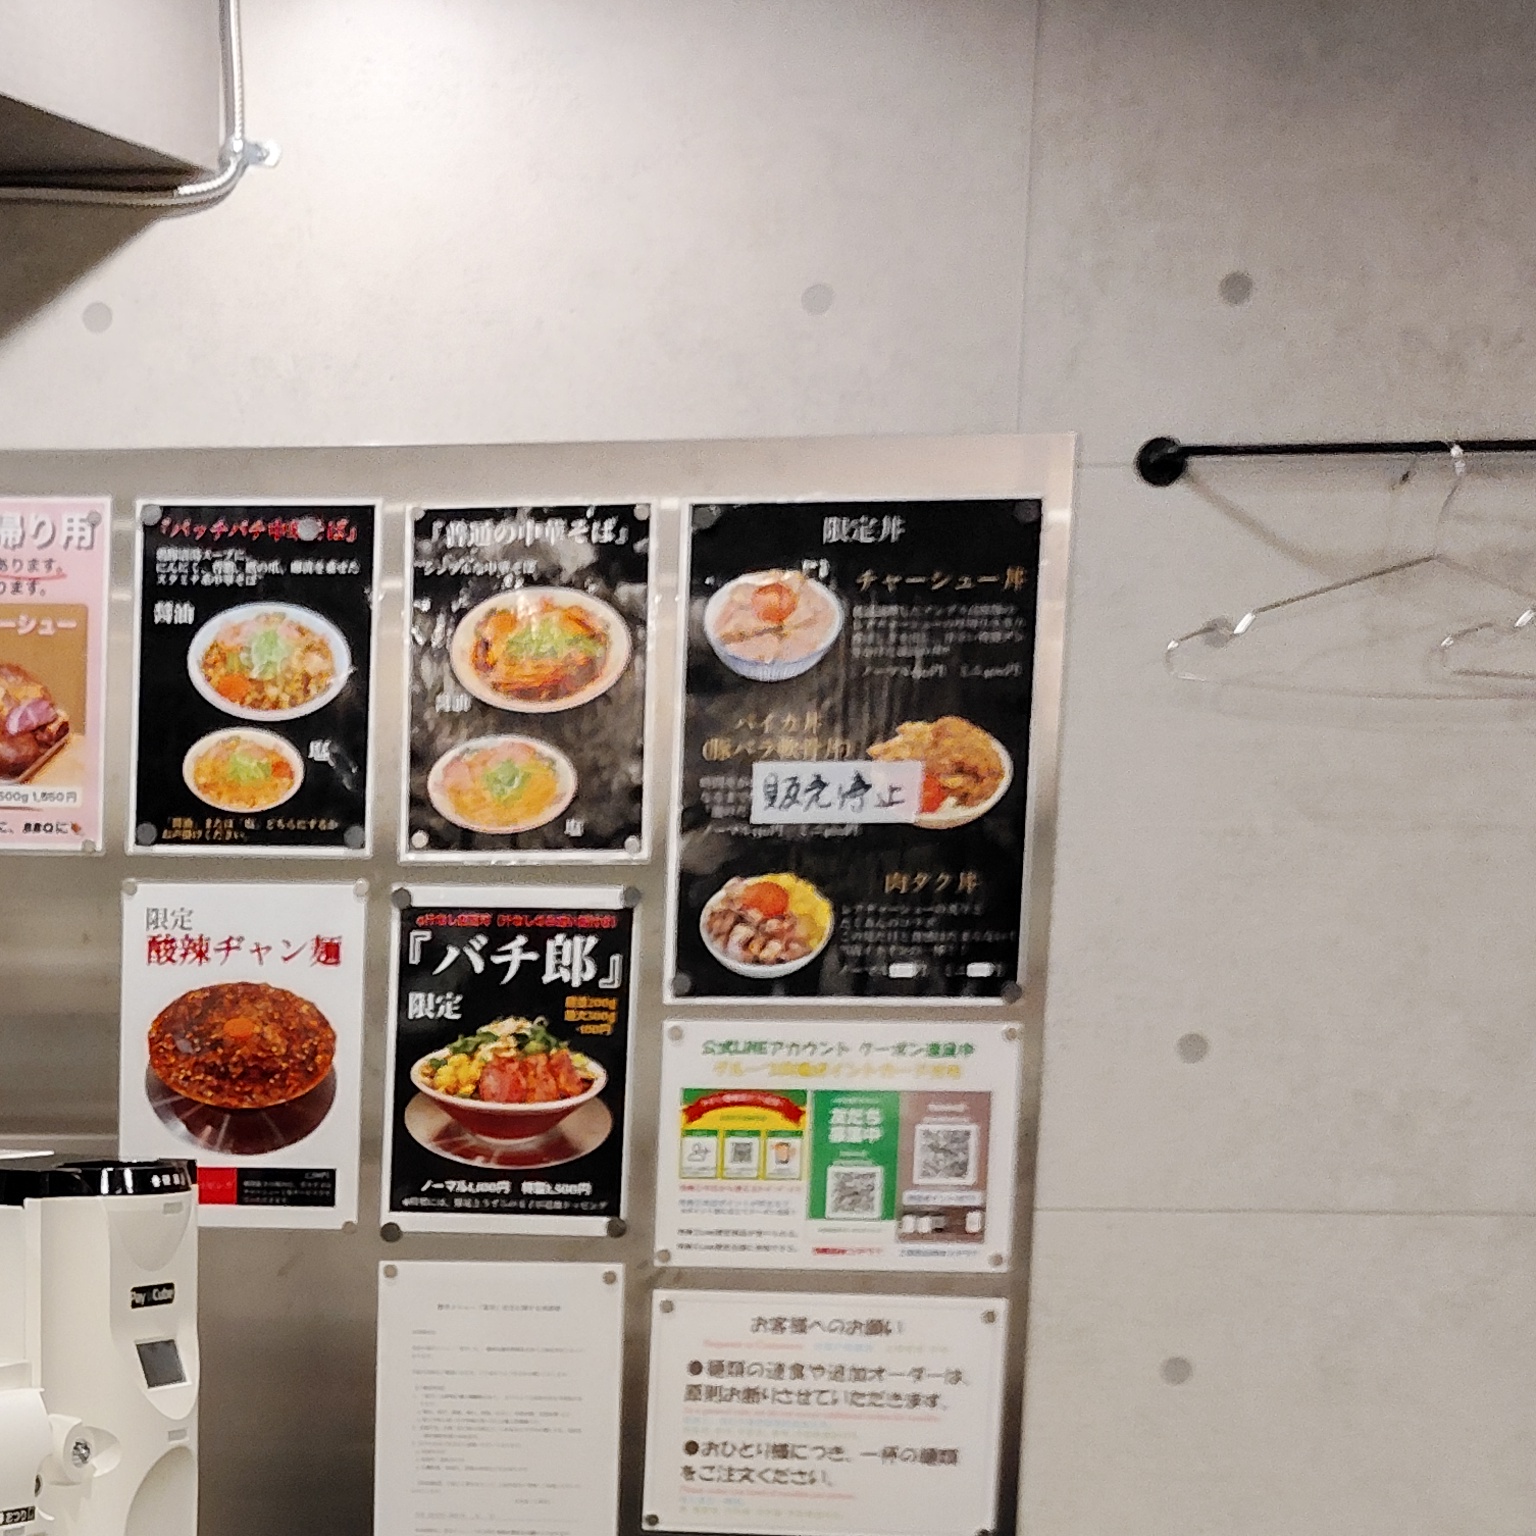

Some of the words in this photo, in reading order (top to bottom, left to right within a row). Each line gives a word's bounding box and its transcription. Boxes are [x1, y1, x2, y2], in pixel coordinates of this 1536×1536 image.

[823, 515, 905, 545] 限定丼
[855, 566, 1027, 592] チャーシュー丼
[145, 907, 193, 931] 限定
[408, 930, 623, 989] 『バチ郎』
[408, 991, 463, 1020] 限定
